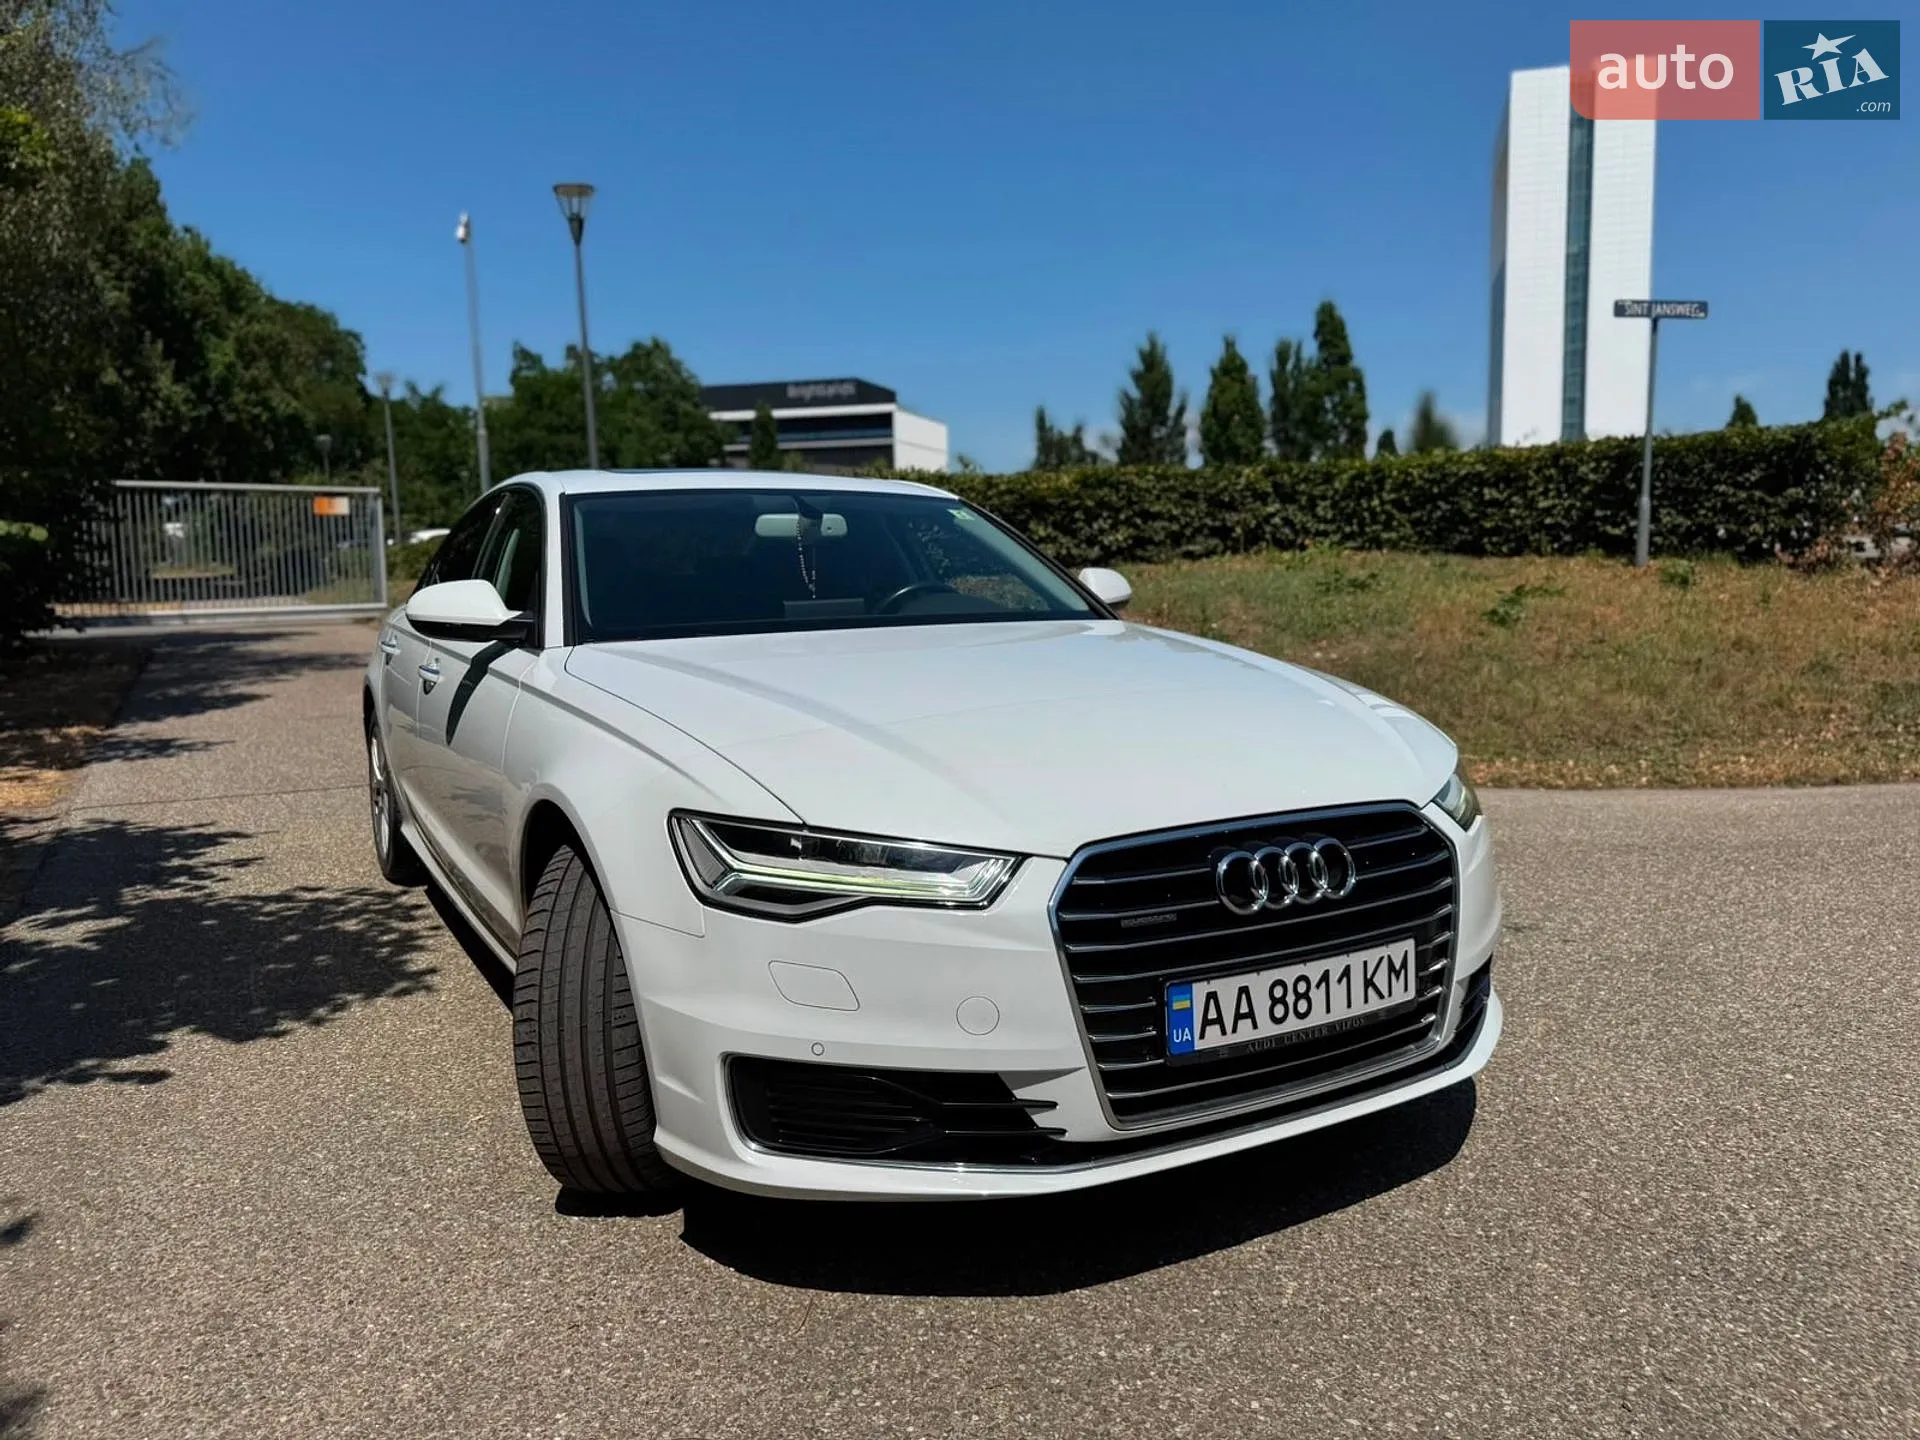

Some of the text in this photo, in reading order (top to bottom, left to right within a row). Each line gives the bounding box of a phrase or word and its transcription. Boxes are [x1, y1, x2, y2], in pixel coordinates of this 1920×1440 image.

[1199, 949, 1409, 1041] AA 8811 KM
[1172, 1027, 1192, 1044] UA
